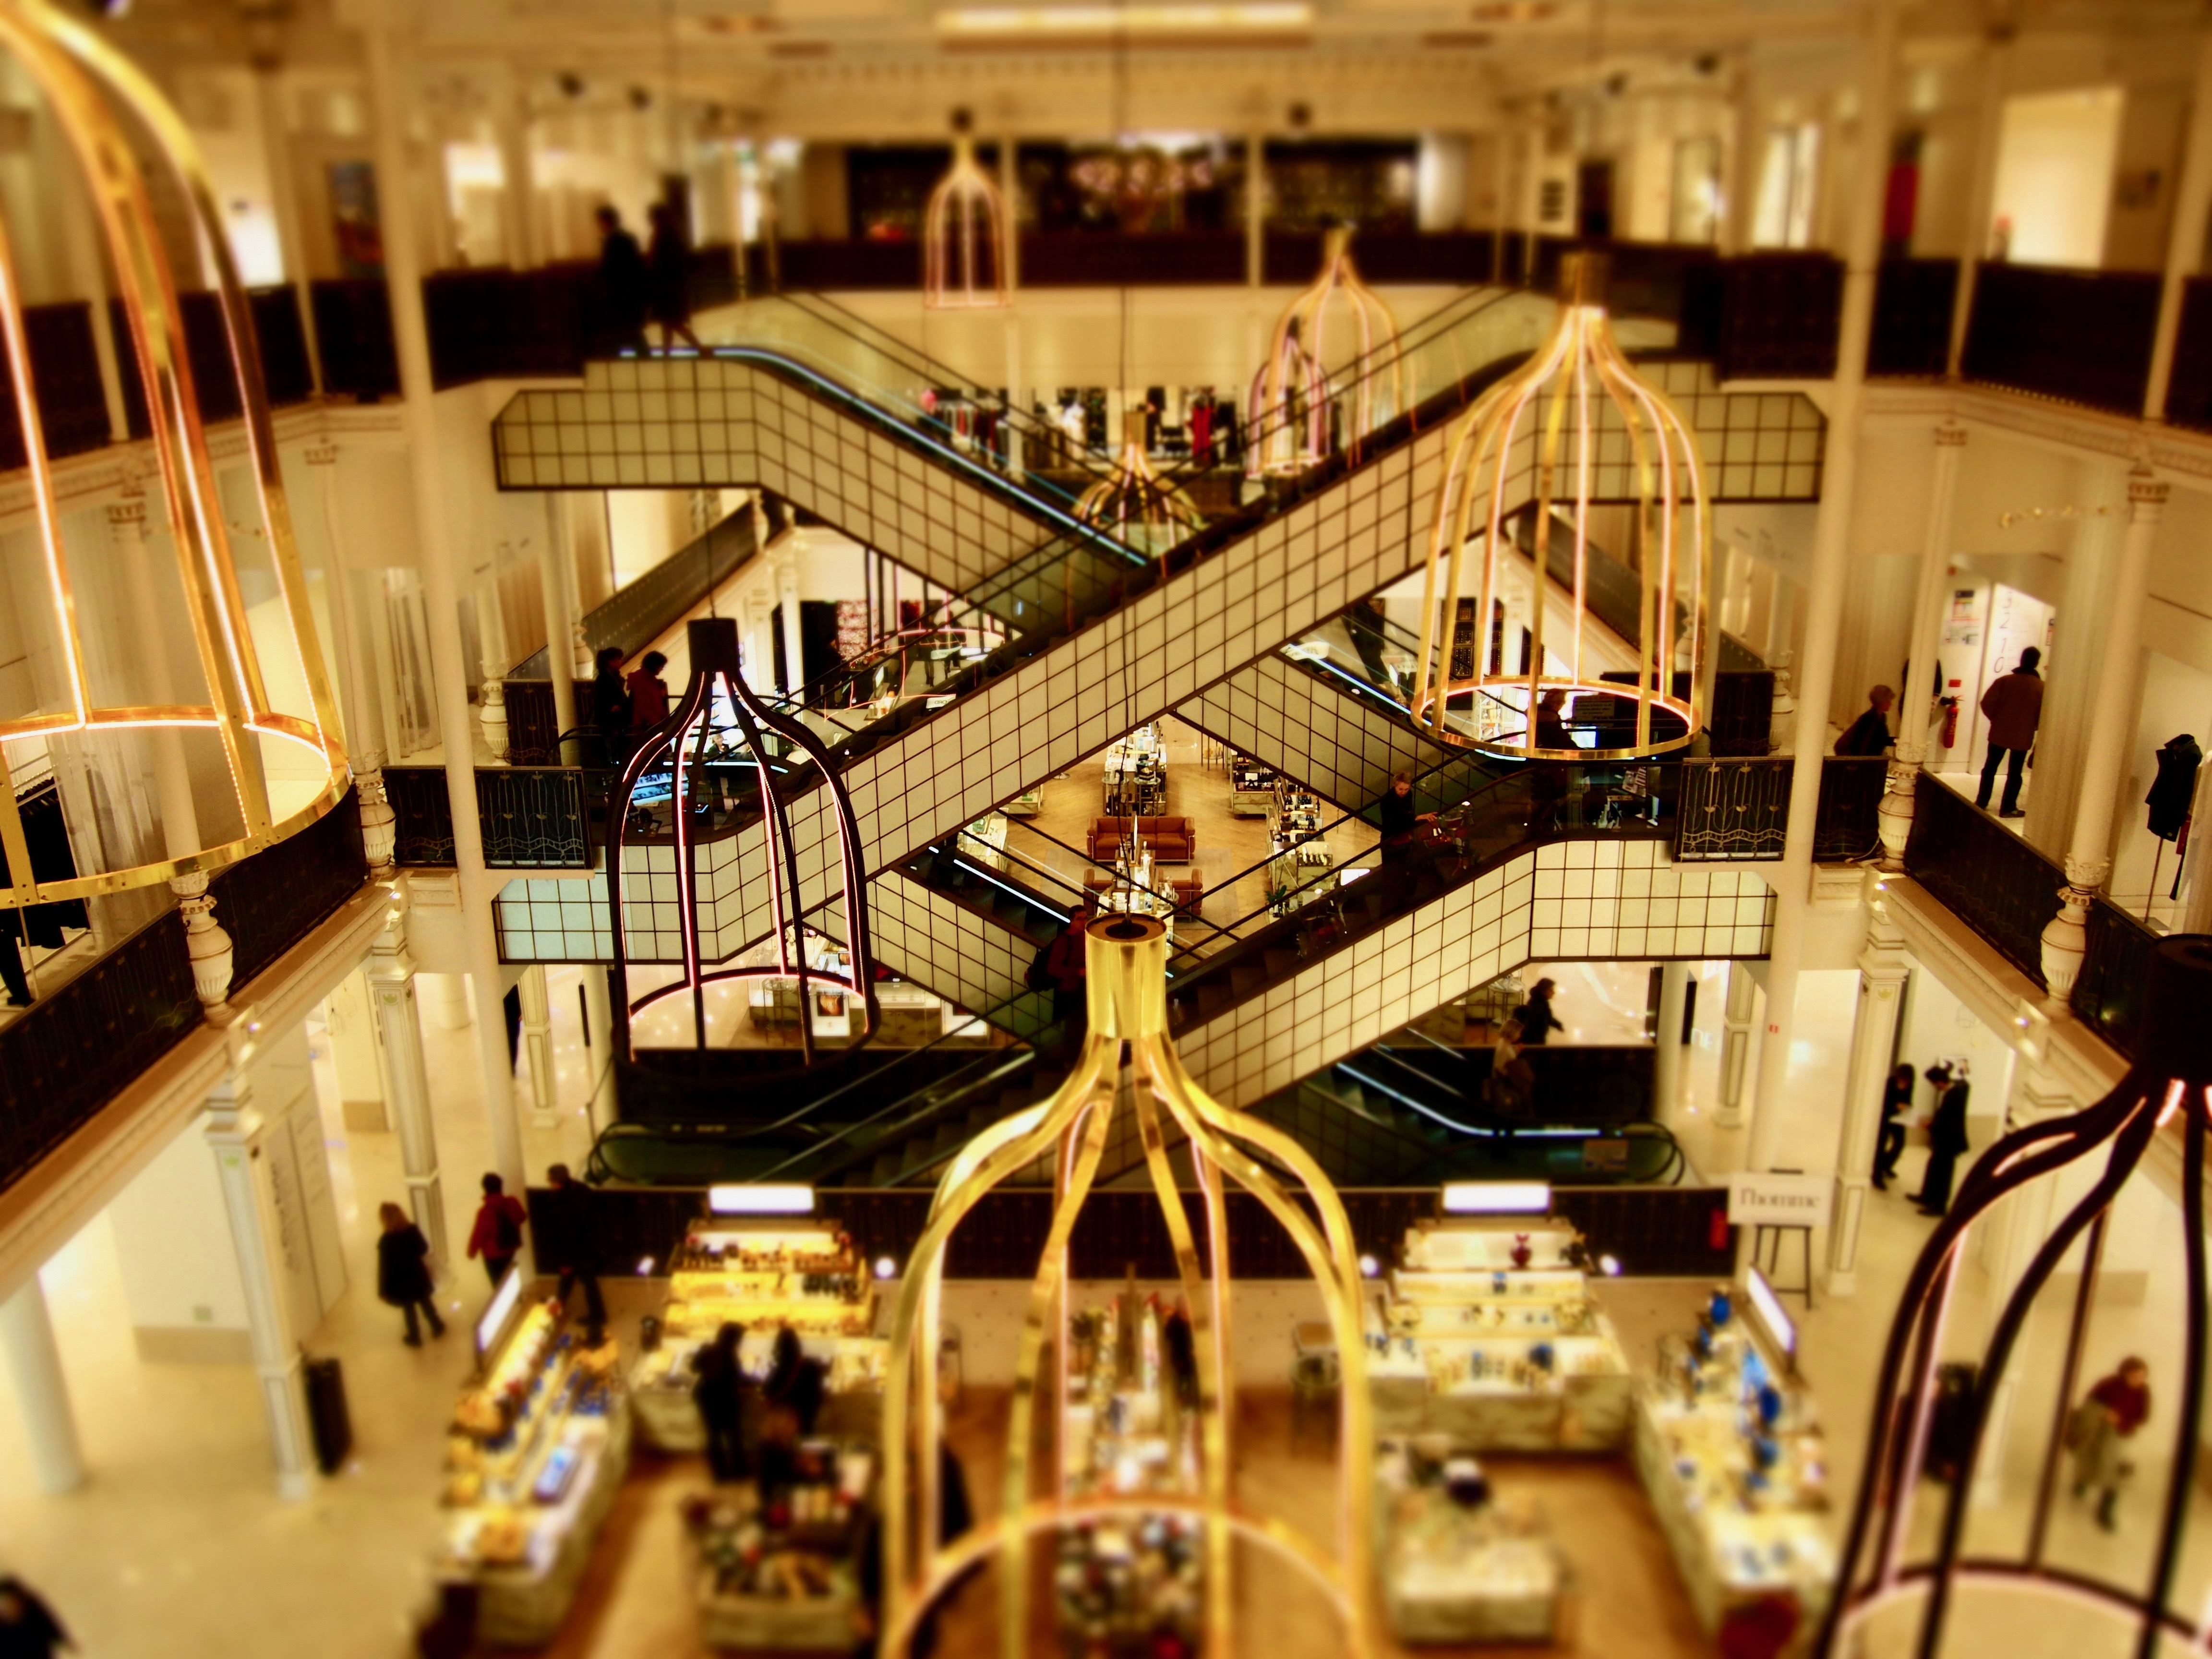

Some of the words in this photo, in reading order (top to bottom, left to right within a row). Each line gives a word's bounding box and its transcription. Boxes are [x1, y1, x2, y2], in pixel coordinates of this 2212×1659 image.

[2003, 591, 2012, 609] 3
[1999, 612, 2009, 629] 2
[2000, 637, 2007, 653] 1
[1994, 656, 2005, 673] 0
